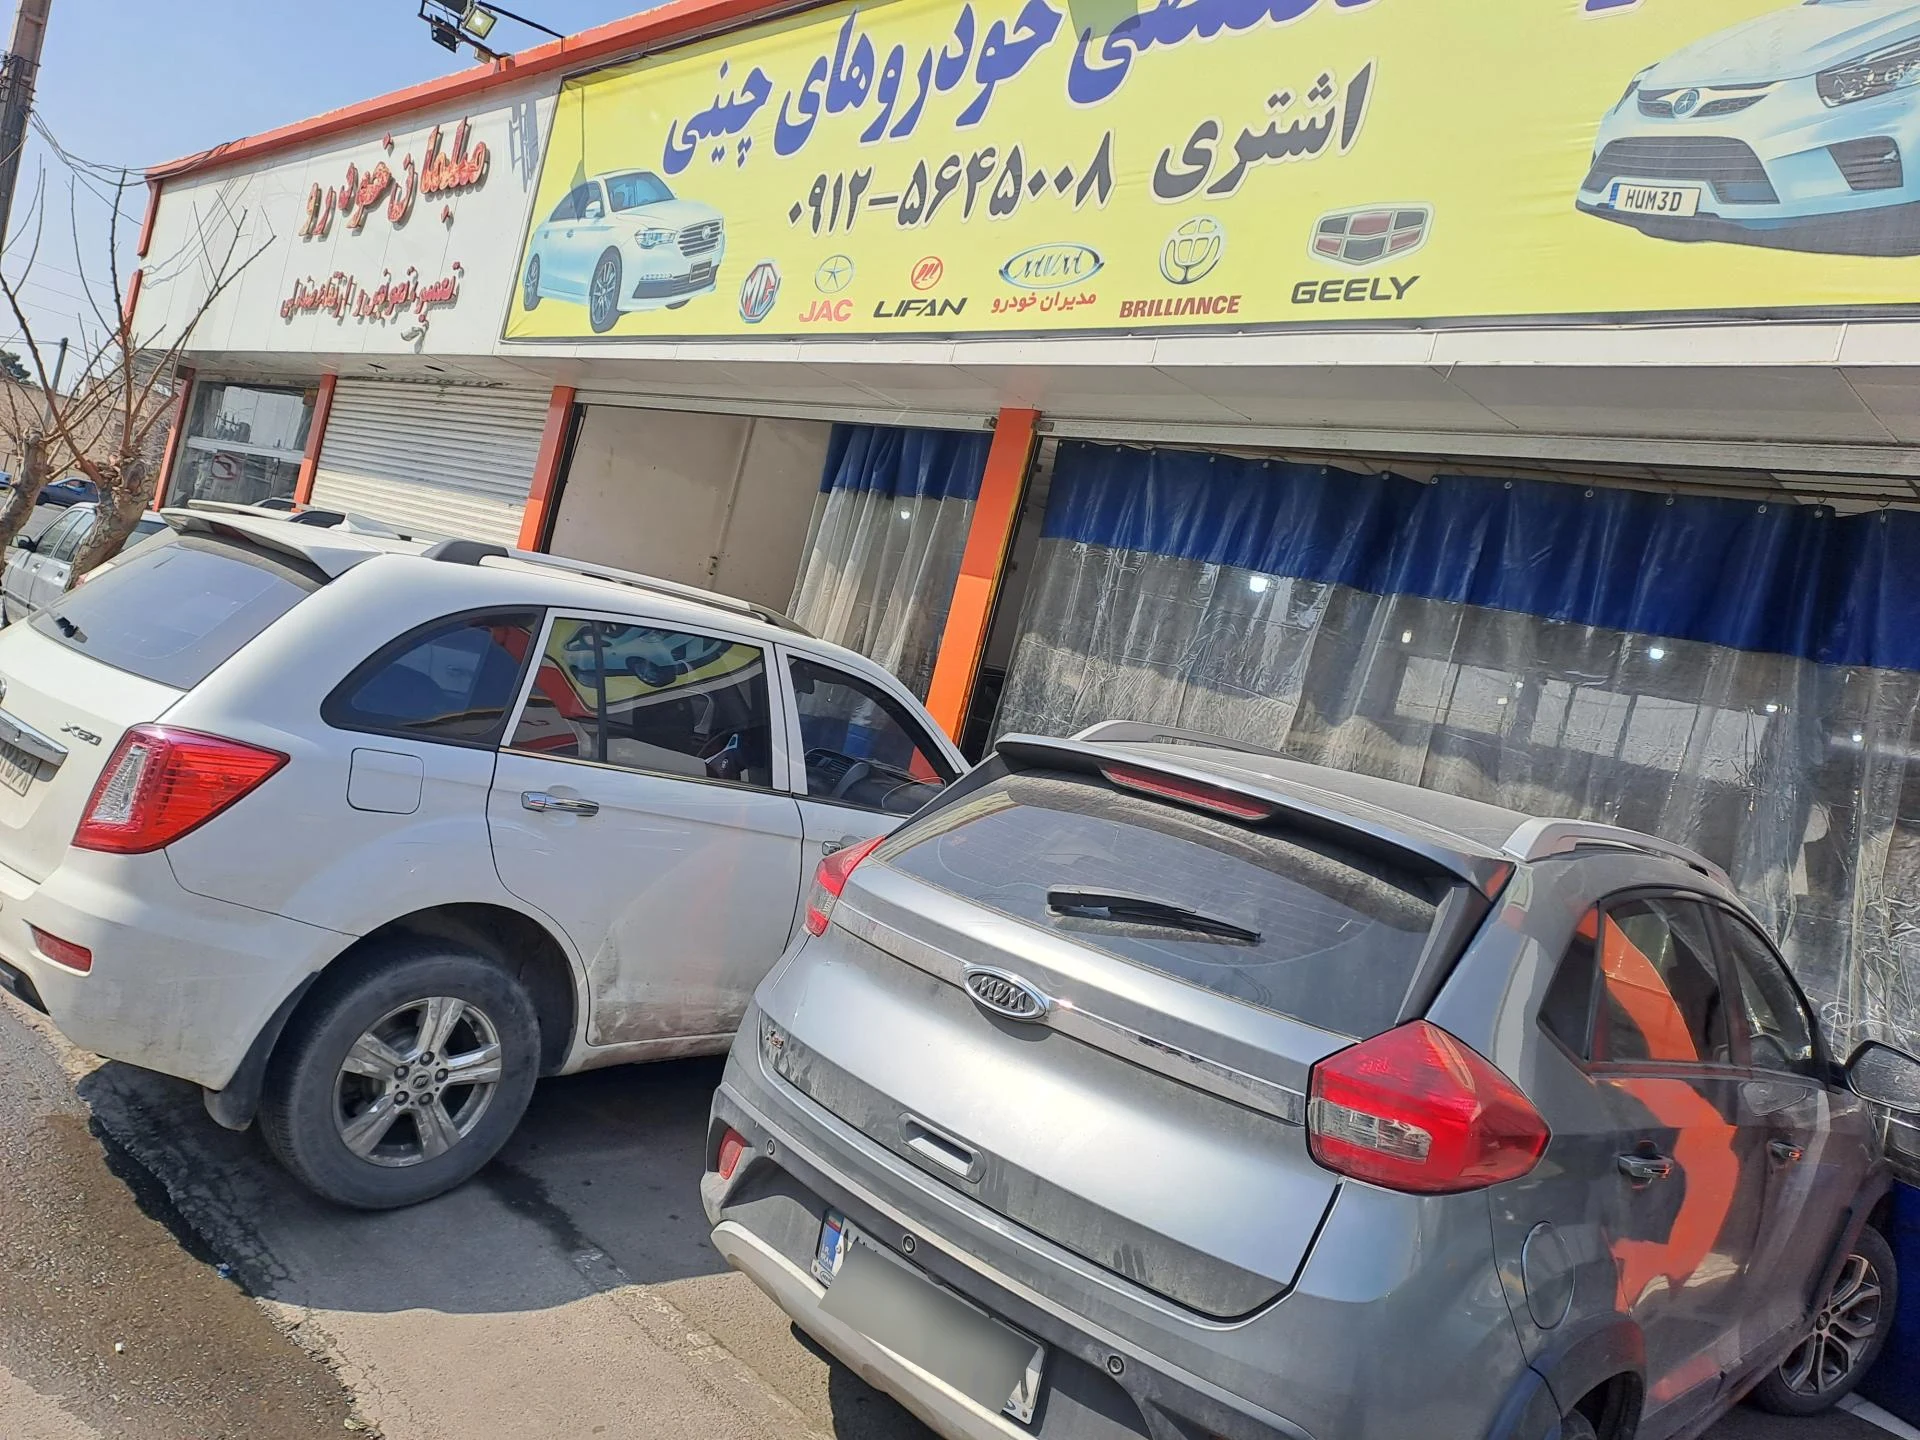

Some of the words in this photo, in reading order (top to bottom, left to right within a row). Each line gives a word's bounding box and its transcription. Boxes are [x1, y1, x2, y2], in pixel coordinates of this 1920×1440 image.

[663, 60, 773, 175] چینی
[1153, 61, 1371, 198] اشتری
[299, 132, 392, 235] خودرو
[788, 130, 1112, 234] ۰۹۱۲-۵۶۴۵۰۰۸
[1625, 188, 1682, 211] HUM3D
[742, 263, 777, 318] MG
[991, 292, 1037, 313] خودرو
[1040, 291, 1097, 312] مدیران
[1291, 275, 1421, 304] GEELY
[799, 299, 853, 322] JAC
[873, 297, 968, 318] LIFAN
[1119, 295, 1242, 318] BRILLIANCE
[973, 976, 1026, 1012] MVM
